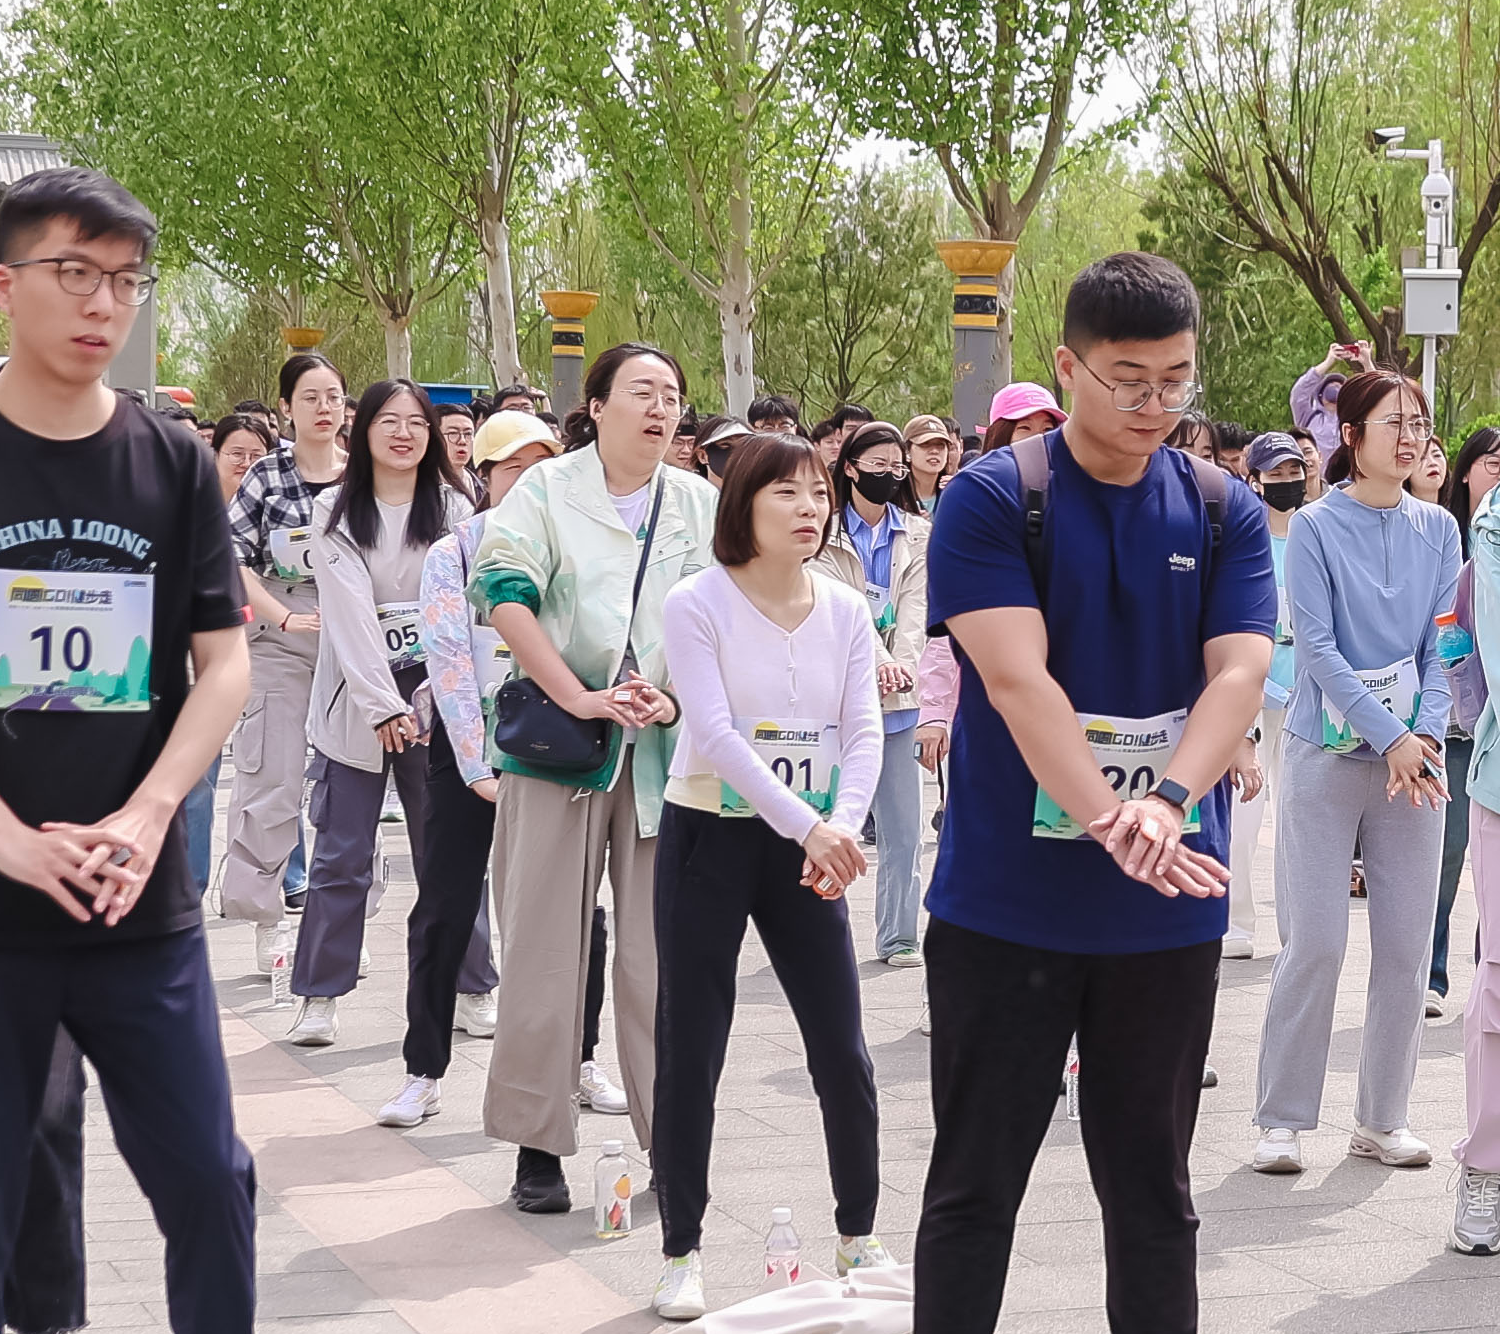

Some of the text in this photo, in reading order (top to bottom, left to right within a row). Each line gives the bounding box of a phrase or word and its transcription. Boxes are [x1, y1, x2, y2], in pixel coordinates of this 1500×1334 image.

[72, 518, 152, 561] LOONG
[1168, 552, 1196, 568] Jeep
[29, 624, 93, 673] 10
[385, 623, 420, 652] 05
[771, 756, 812, 792] 01
[1100, 765, 1155, 800] 20
